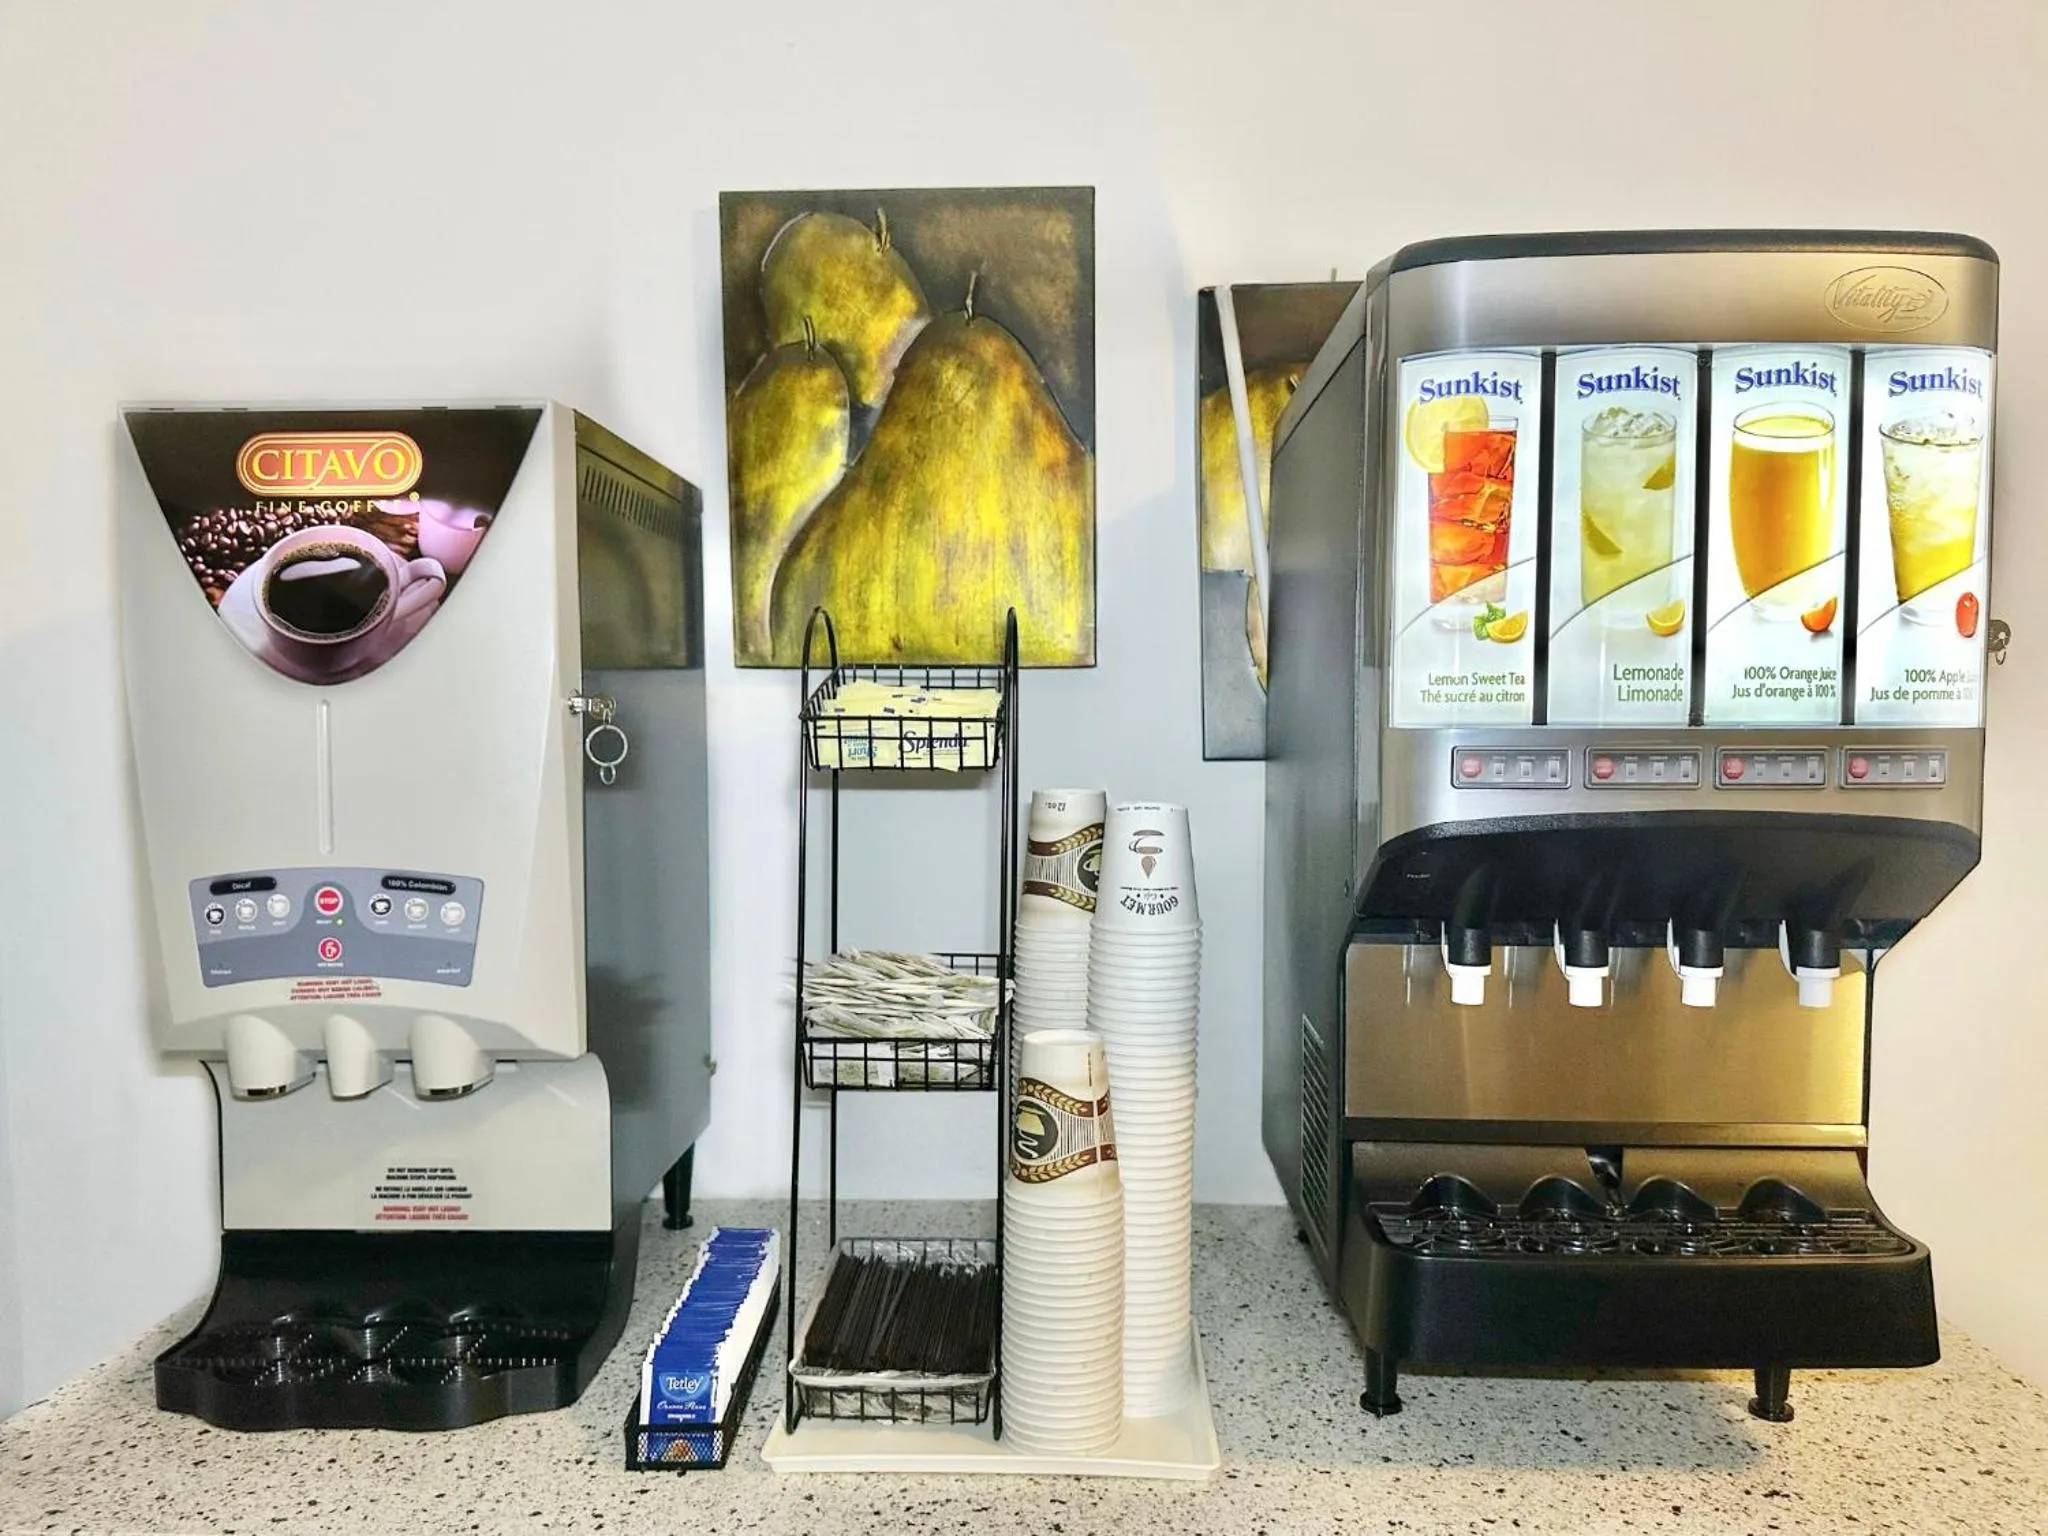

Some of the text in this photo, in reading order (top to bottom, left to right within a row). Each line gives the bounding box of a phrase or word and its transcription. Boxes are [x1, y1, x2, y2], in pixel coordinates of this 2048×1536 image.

[1419, 371, 1523, 404] Sunkist
[1577, 366, 1681, 400] Sunkist
[1736, 360, 1837, 397] Sunkist
[1888, 367, 1983, 401] Sunkist
[252, 448, 406, 482] CITAVO
[256, 500, 402, 513] FINE COFF
[1428, 673, 1525, 686] Lemon Sweet Tea
[1613, 663, 1684, 681] Lemonade
[1744, 667, 1777, 681] 100%
[1779, 667, 1819, 685] Orange
[1905, 669, 1937, 683] 100%
[1938, 669, 1966, 687] Apple
[1420, 689, 1525, 702] Thé sucré au citron
[1617, 684, 1683, 702] Limonade
[1732, 684, 1751, 699] Jus
[1754, 683, 1805, 701] d'orange
[1815, 684, 1837, 698] 100%
[1870, 686, 1889, 702] Jus
[1893, 686, 1909, 700] de
[1912, 689, 1955, 705] pomme
[232, 881, 252, 890] Decaf
[1120, 894, 1180, 916] GOURMET
[666, 1376, 703, 1394] Tetley
